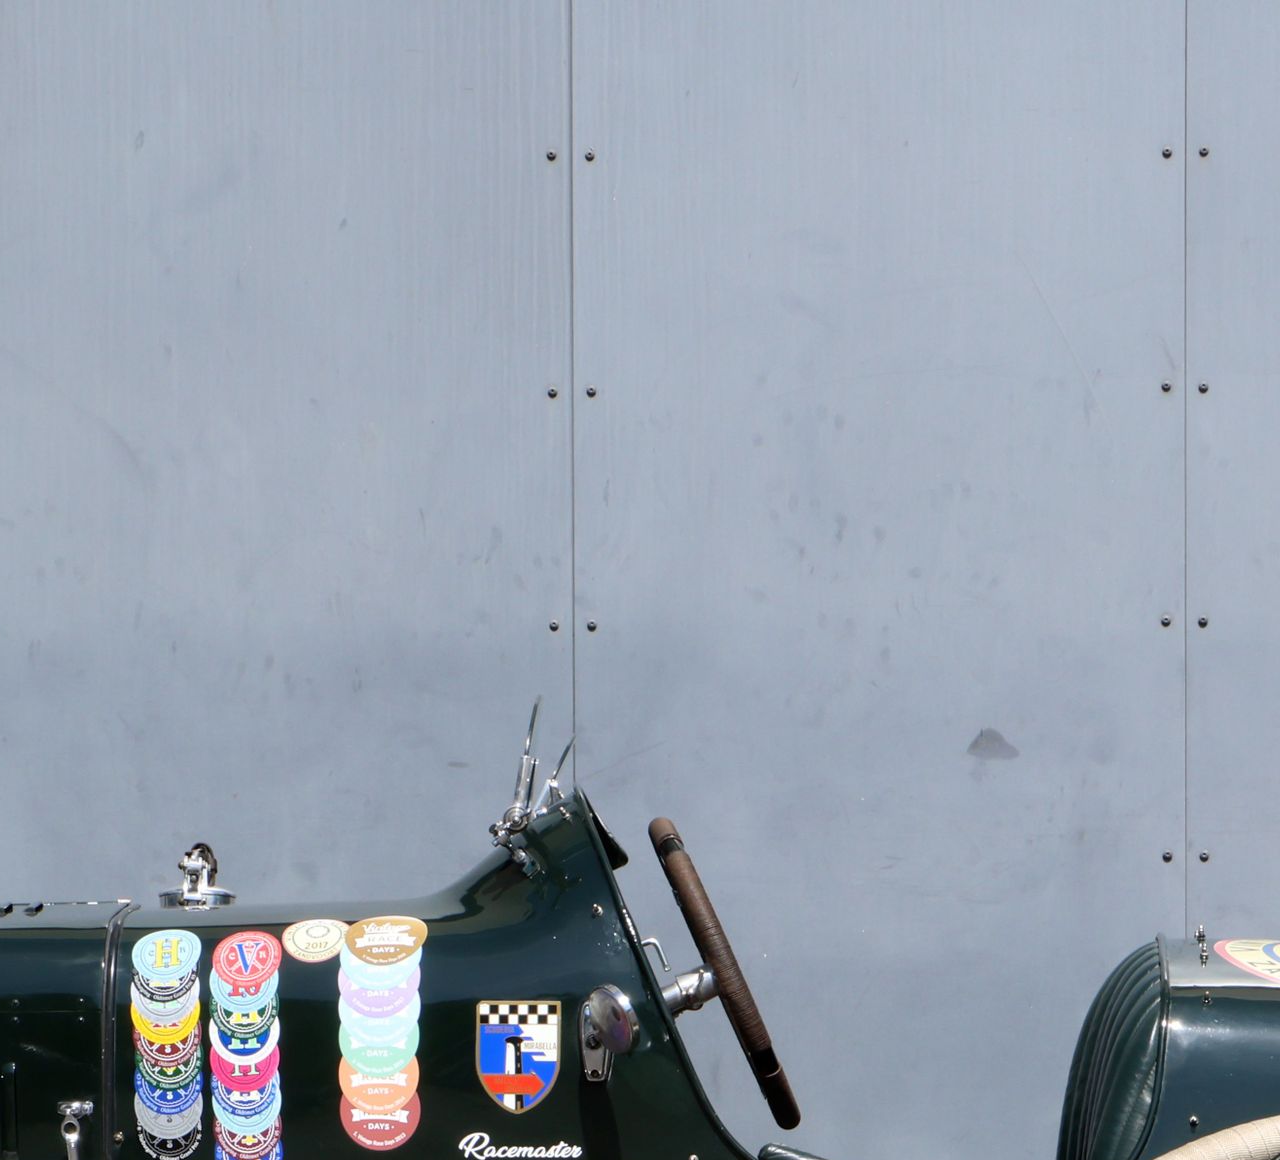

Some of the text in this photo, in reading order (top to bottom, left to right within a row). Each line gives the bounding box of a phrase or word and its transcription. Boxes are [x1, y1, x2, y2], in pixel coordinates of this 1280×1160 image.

[367, 935, 401, 943] RACE
[304, 941, 328, 950] 2017
[234, 941, 265, 975] V
[367, 1049, 389, 1057] DAYS
[367, 1087, 389, 1095] DAYS
[367, 1122, 390, 1130] DAYS
[458, 1131, 583, 1160] Racemaster
